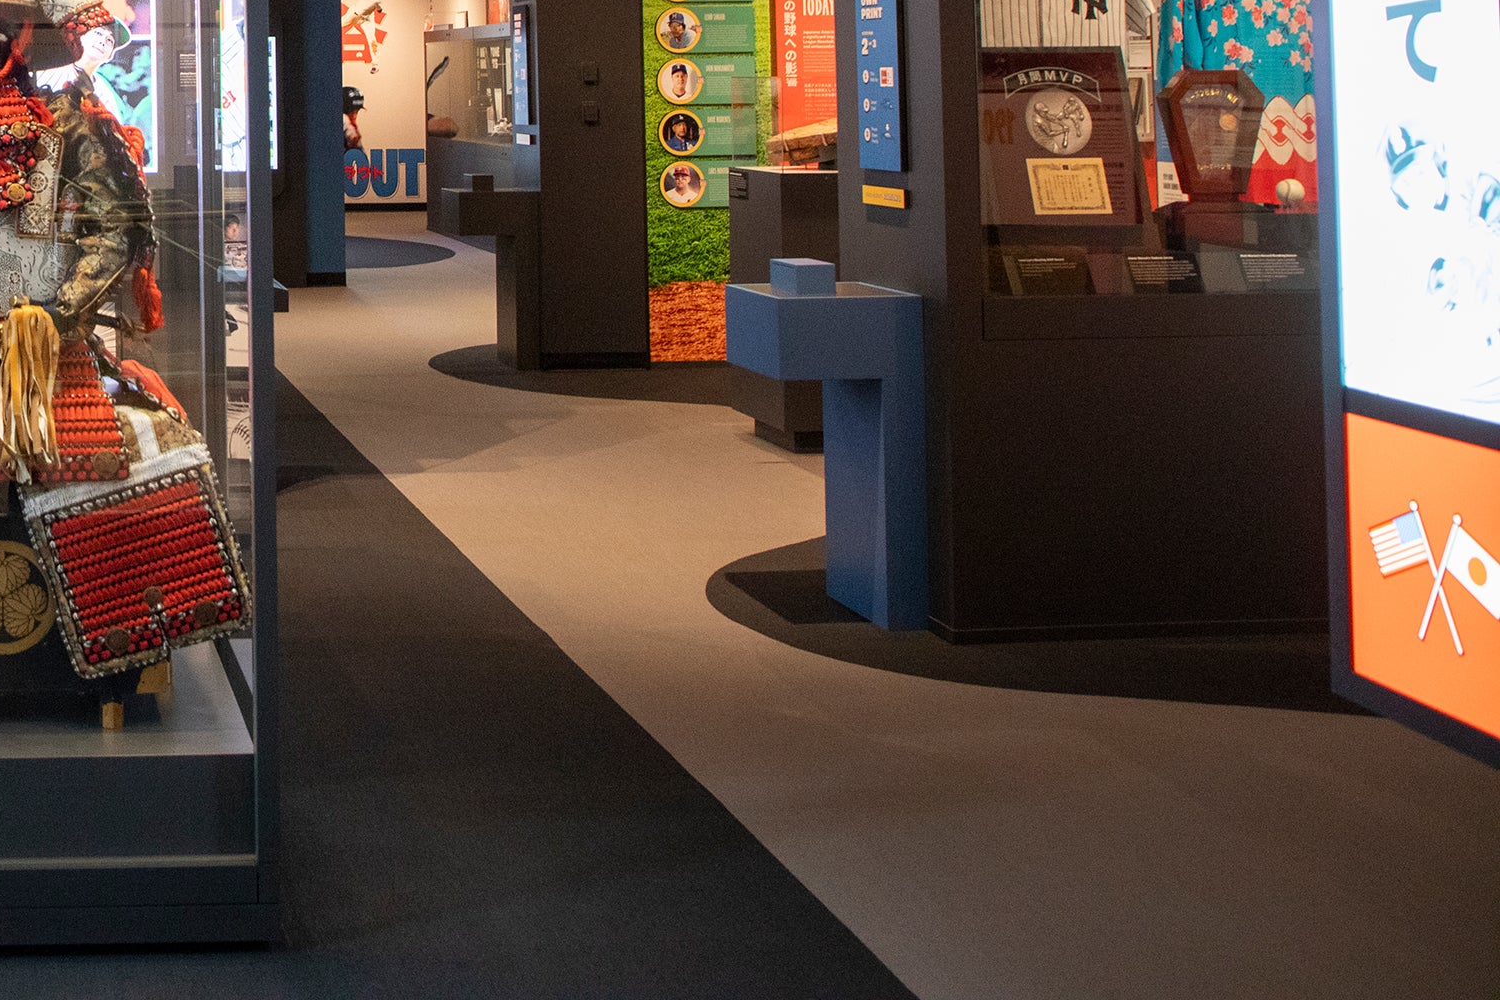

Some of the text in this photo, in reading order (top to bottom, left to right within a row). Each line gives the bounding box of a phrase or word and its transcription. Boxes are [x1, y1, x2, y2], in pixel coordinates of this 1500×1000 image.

[861, 7, 882, 20] PRINT
[861, 38, 868, 55] 2
[343, 149, 424, 198] OUT
